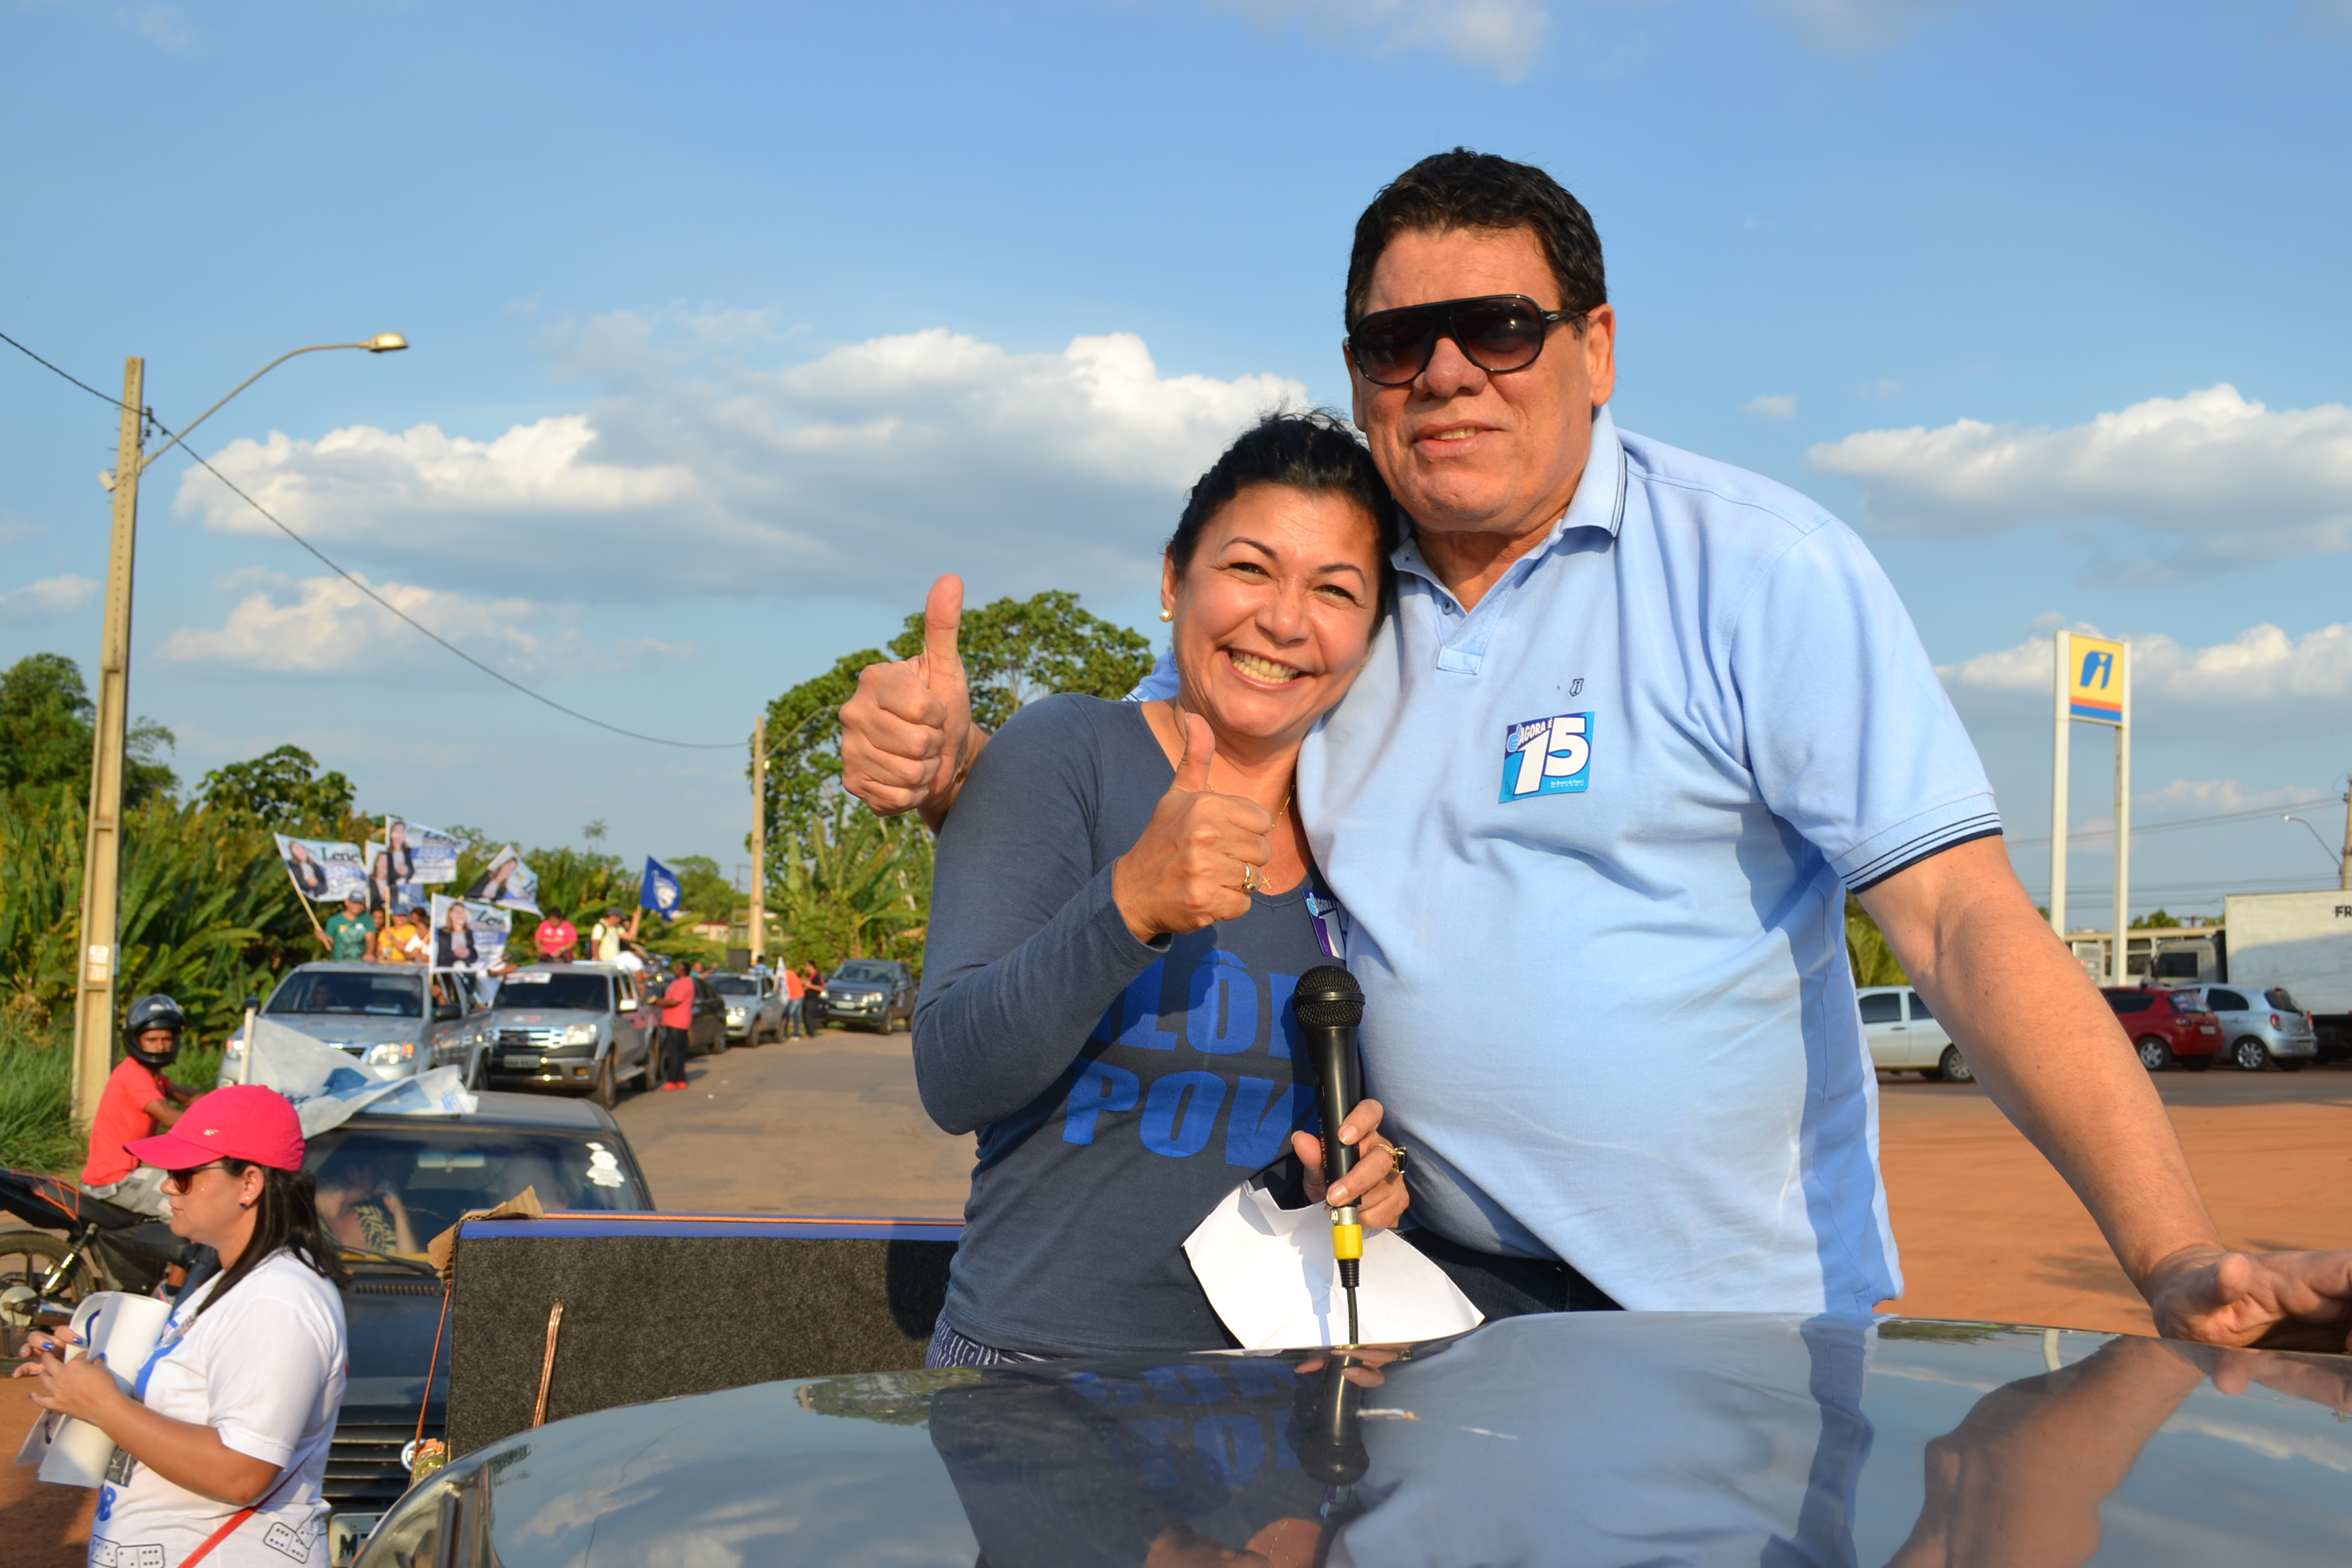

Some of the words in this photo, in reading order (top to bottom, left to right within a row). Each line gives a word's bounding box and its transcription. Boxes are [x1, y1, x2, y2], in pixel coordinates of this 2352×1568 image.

[1518, 721, 1546, 747] AGORA
[1548, 717, 1553, 729] É
[1514, 717, 1590, 795] 15
[1314, 898, 1333, 913] AGORA
[2335, 905, 2352, 918] FR
